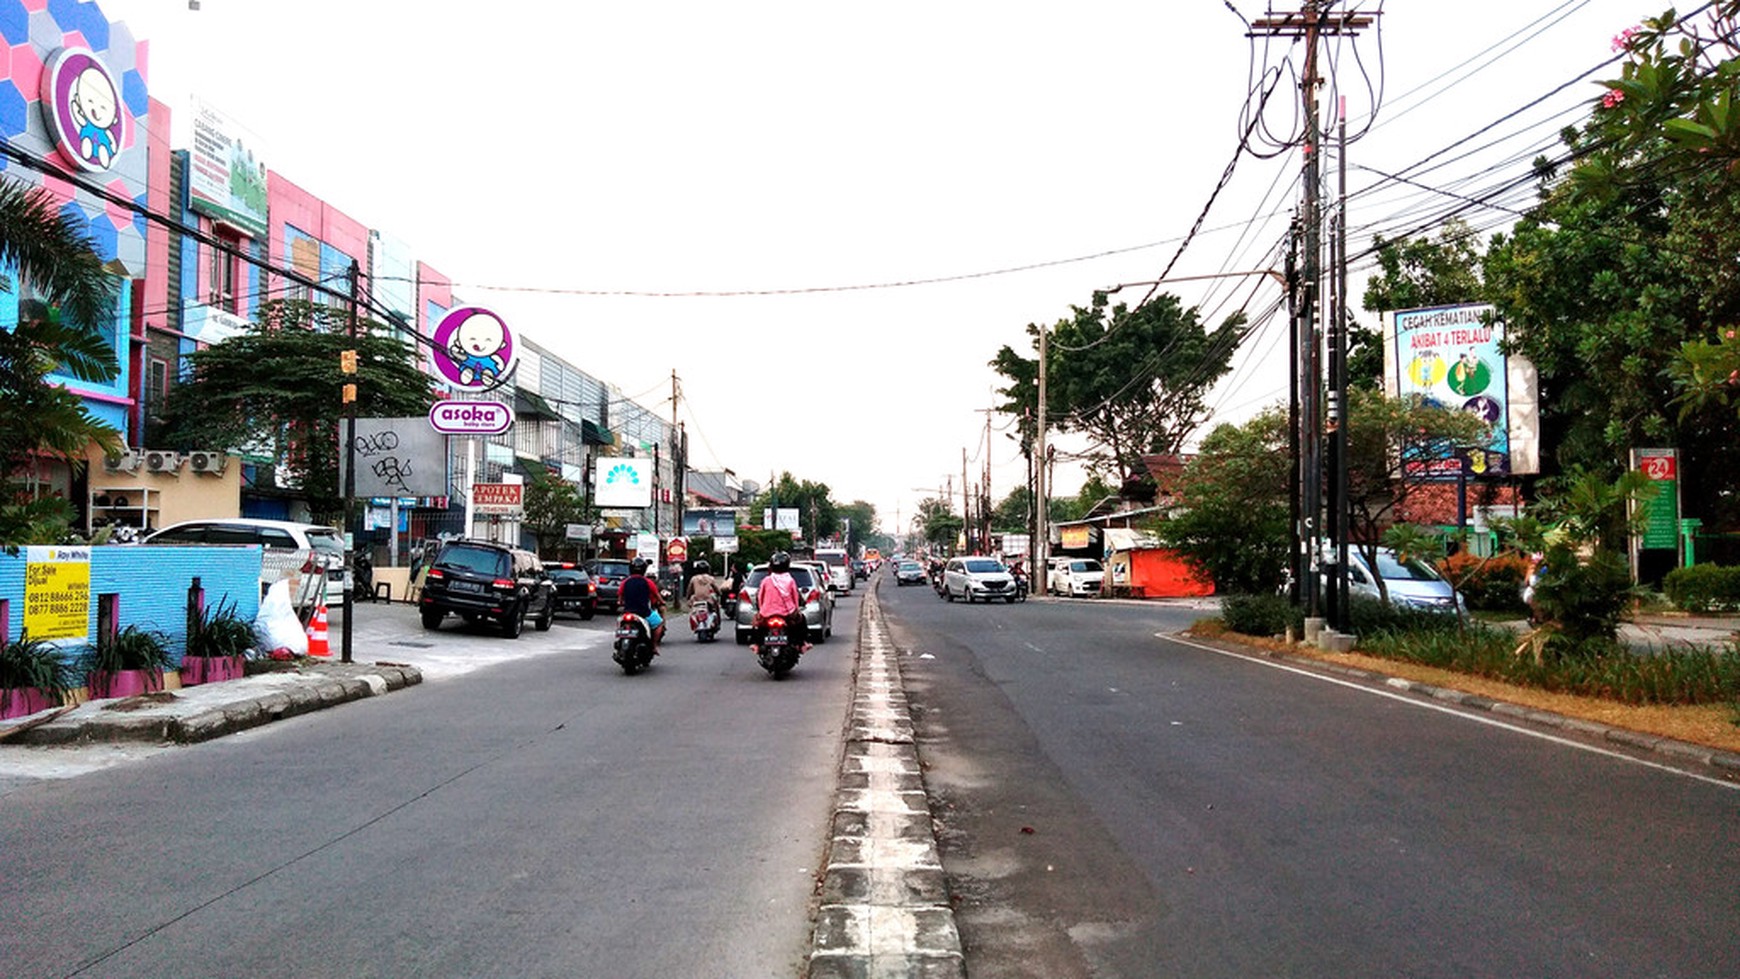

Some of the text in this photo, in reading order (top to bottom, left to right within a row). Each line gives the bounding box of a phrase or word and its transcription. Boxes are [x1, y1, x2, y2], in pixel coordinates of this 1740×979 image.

[1402, 314, 1433, 331] CEGAH
[1434, 309, 1480, 327] KEMATIAN
[1411, 327, 1491, 349] AKIBAT 4 TERLALU
[442, 405, 495, 421] asoka
[1651, 461, 1666, 475] 24
[473, 485, 517, 495] APOTEK
[58, 551, 88, 561] Ray White
[29, 564, 57, 576] For Sale
[28, 575, 48, 587] Dijual
[29, 592, 49, 603] 0812
[28, 604, 48, 615] 0877
